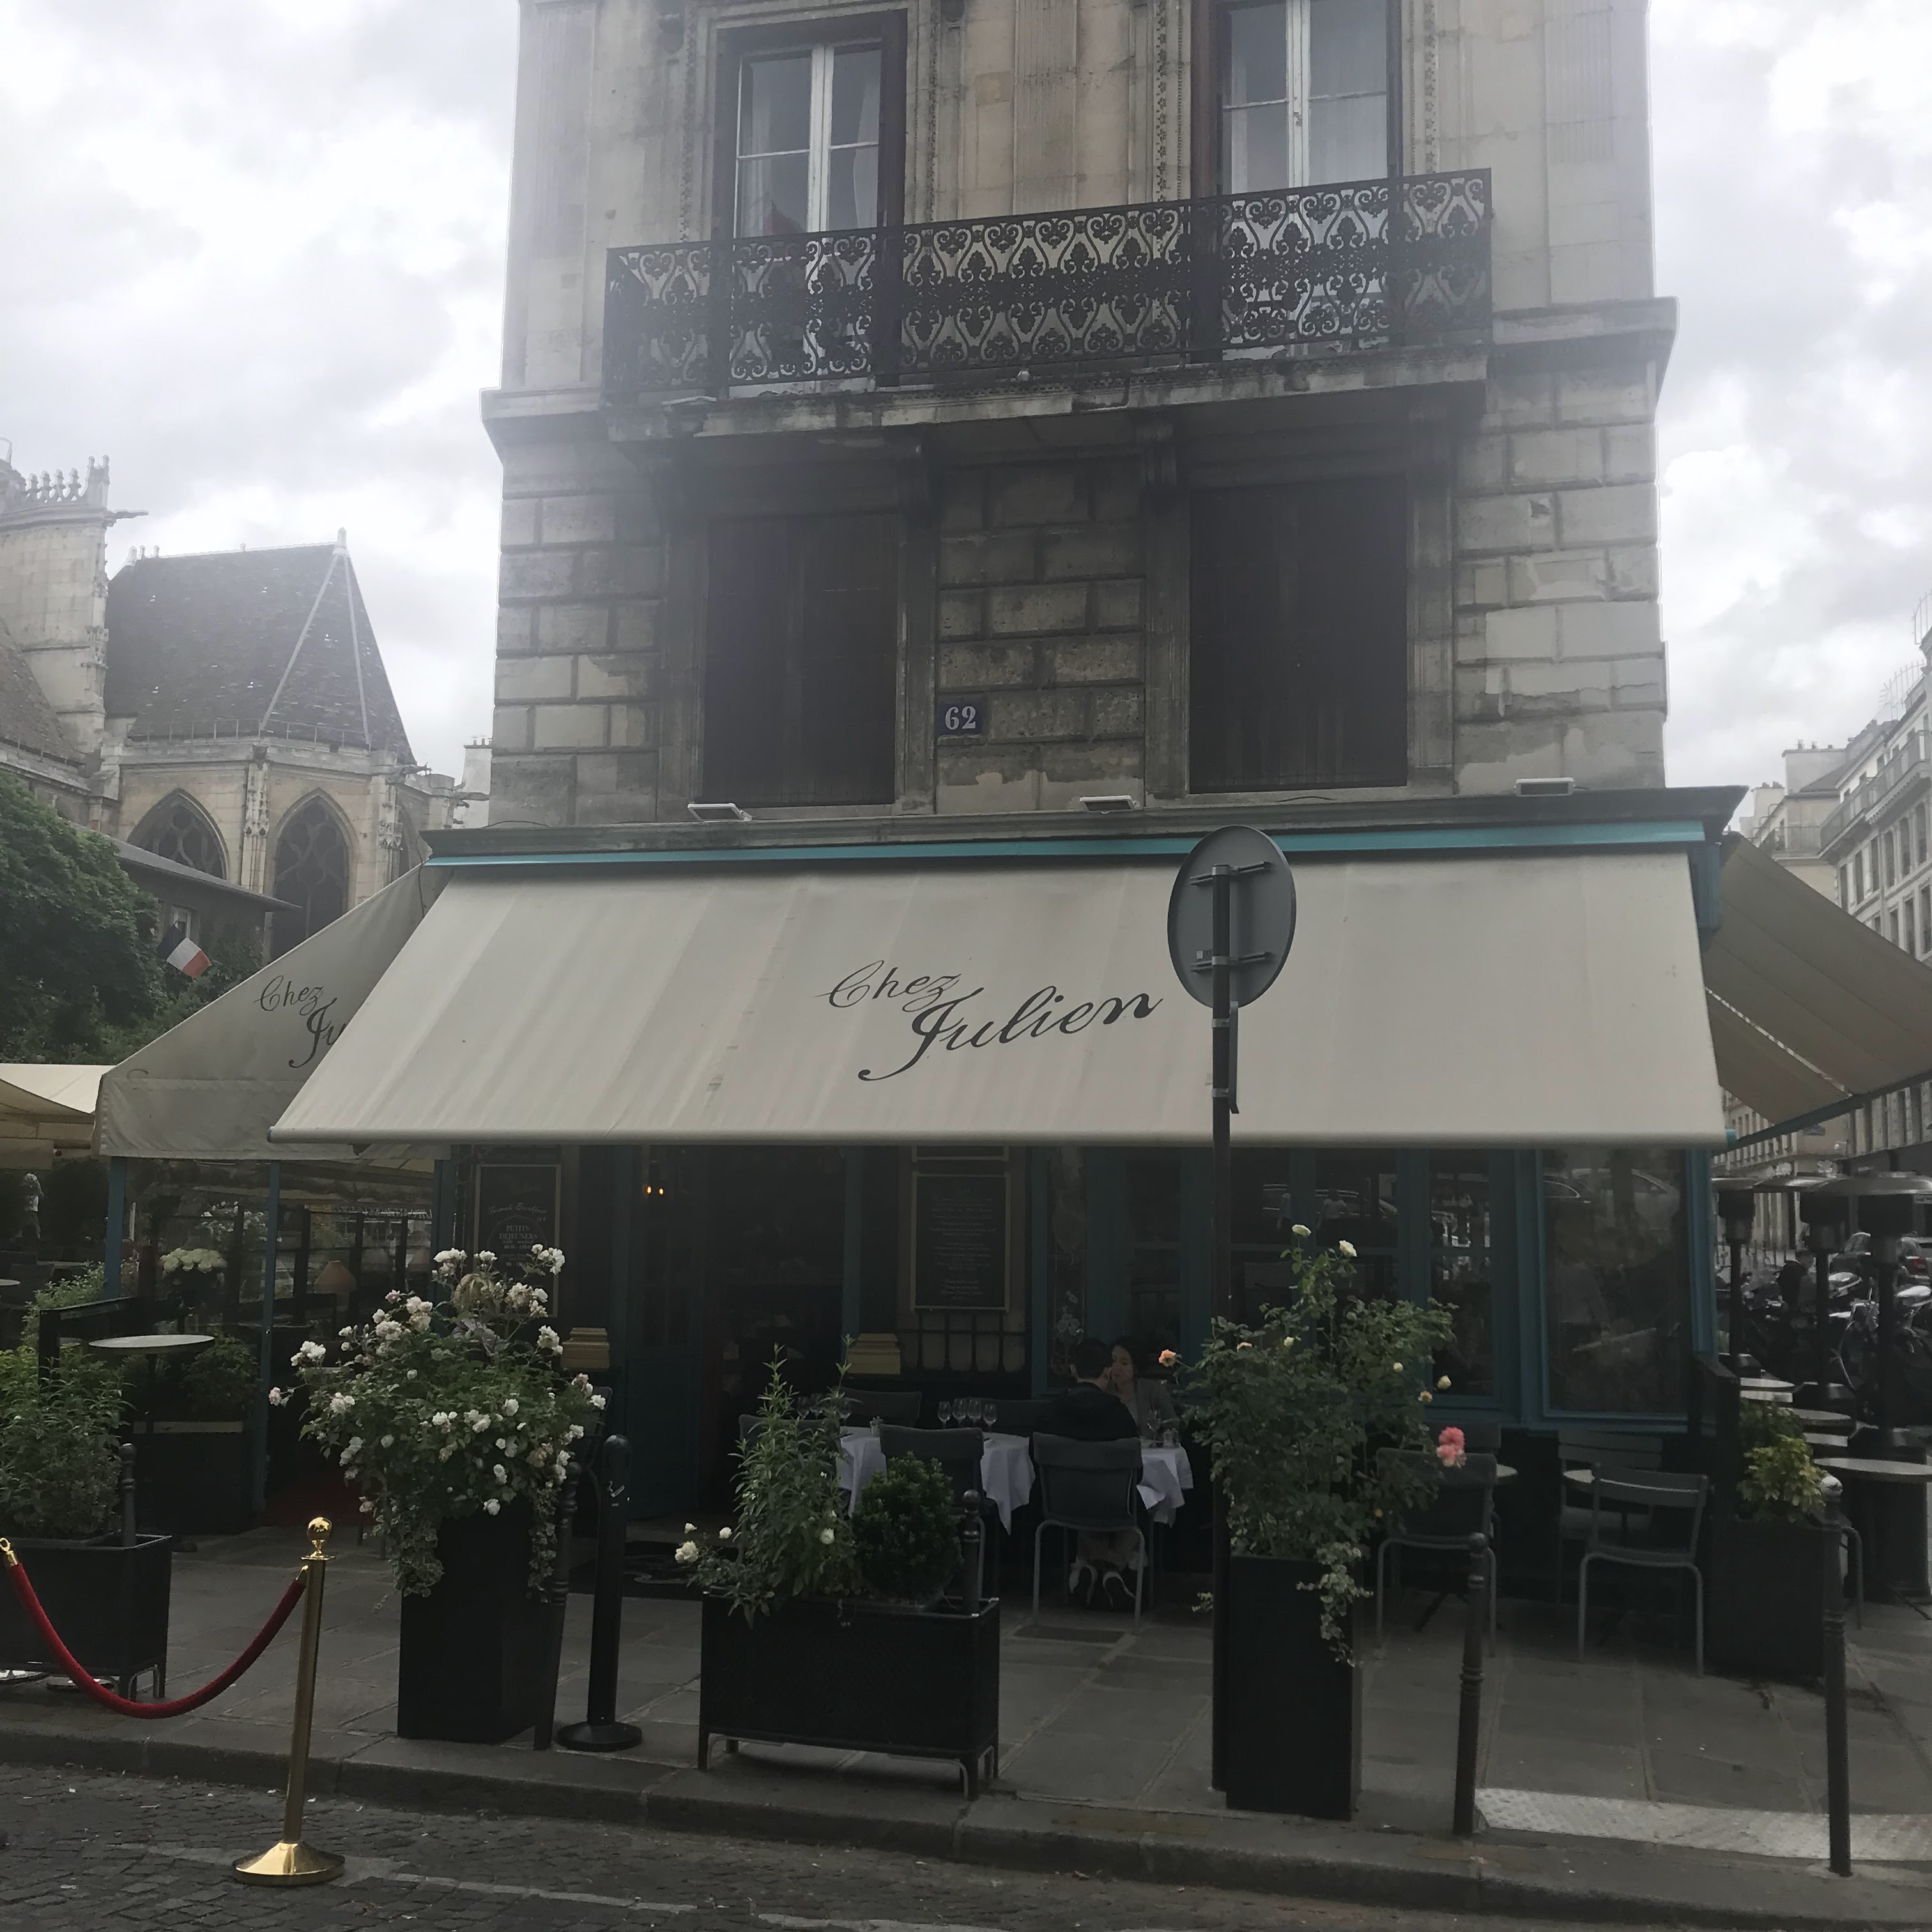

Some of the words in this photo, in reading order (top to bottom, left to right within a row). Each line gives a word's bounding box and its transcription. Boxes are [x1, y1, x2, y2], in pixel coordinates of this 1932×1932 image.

[944, 705, 977, 730] 62
[252, 974, 325, 1016] Chez
[813, 959, 962, 1013] Chez
[857, 985, 1164, 1082] Julien
